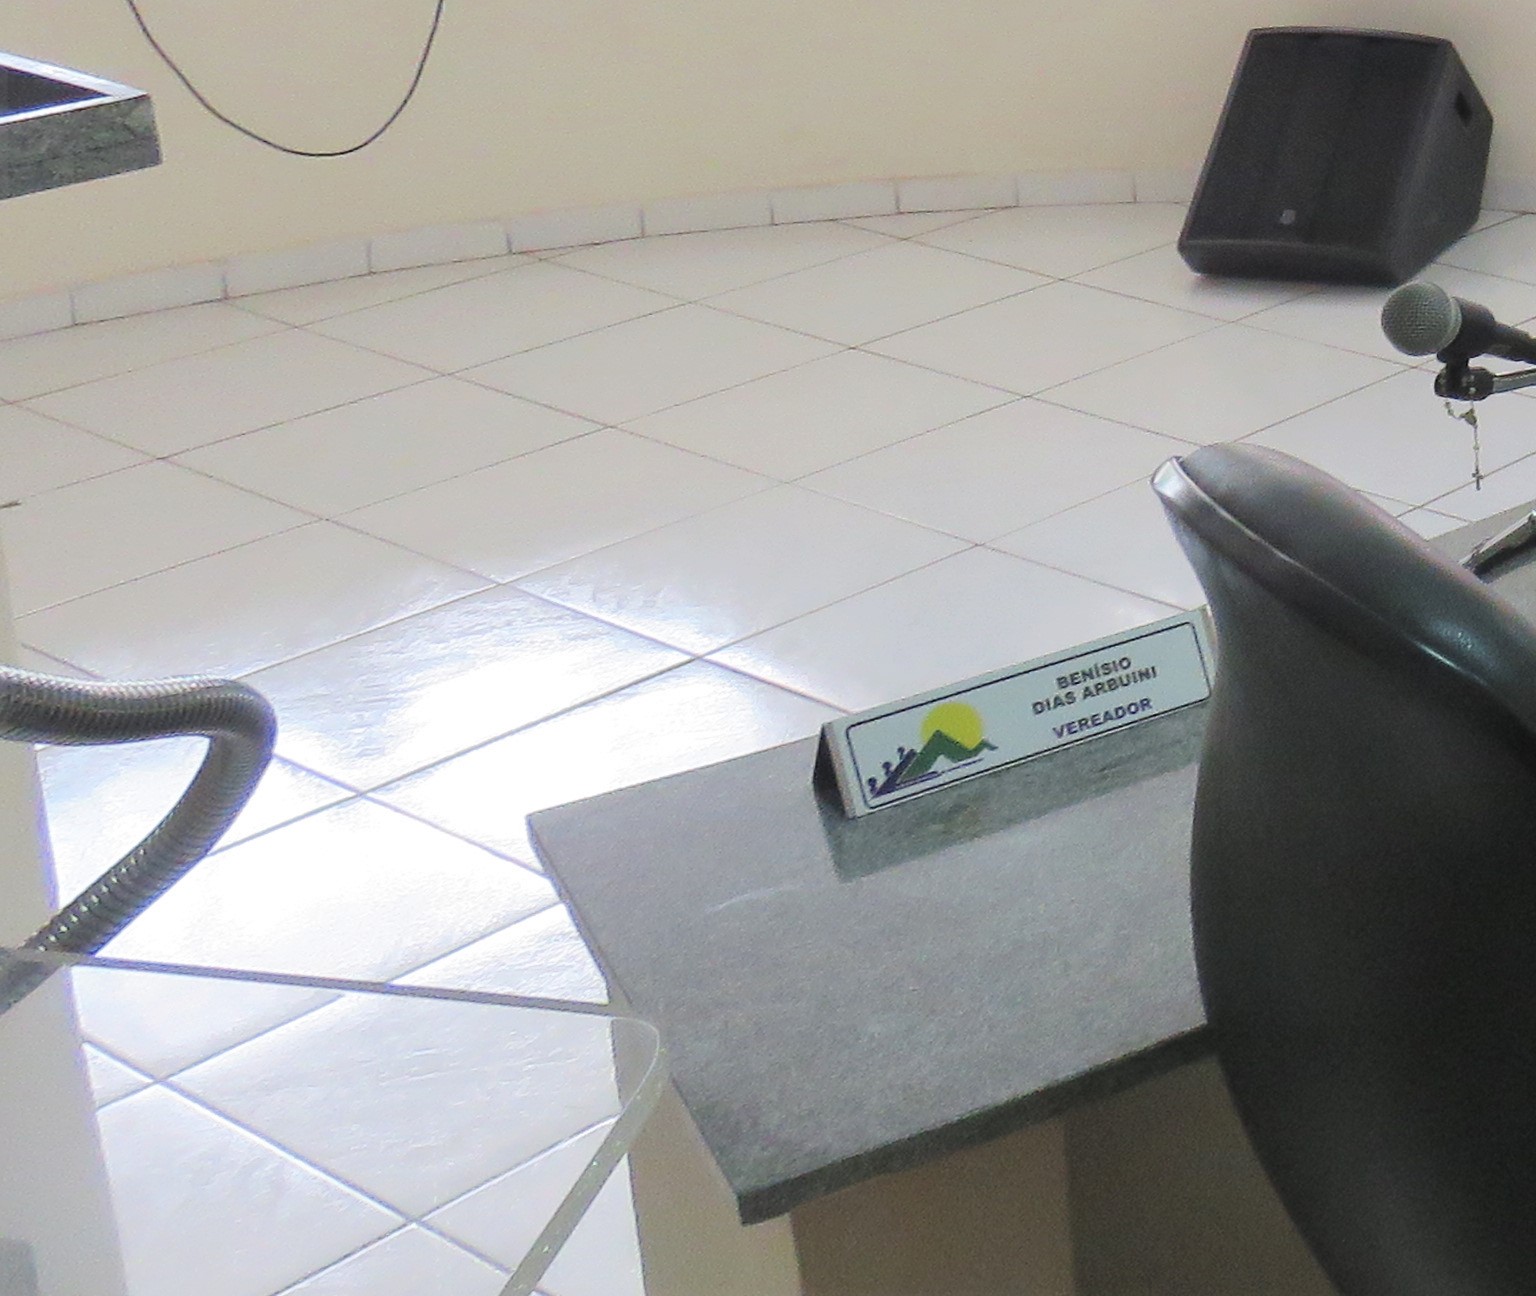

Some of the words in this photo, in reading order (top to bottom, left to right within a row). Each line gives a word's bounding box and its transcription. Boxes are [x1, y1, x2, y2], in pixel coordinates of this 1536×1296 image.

[1031, 690, 1077, 716] DIAS
[1081, 665, 1158, 701] ARBUINI
[1056, 656, 1131, 689] BENÍSIO
[1052, 697, 1153, 738] VEREADOR
